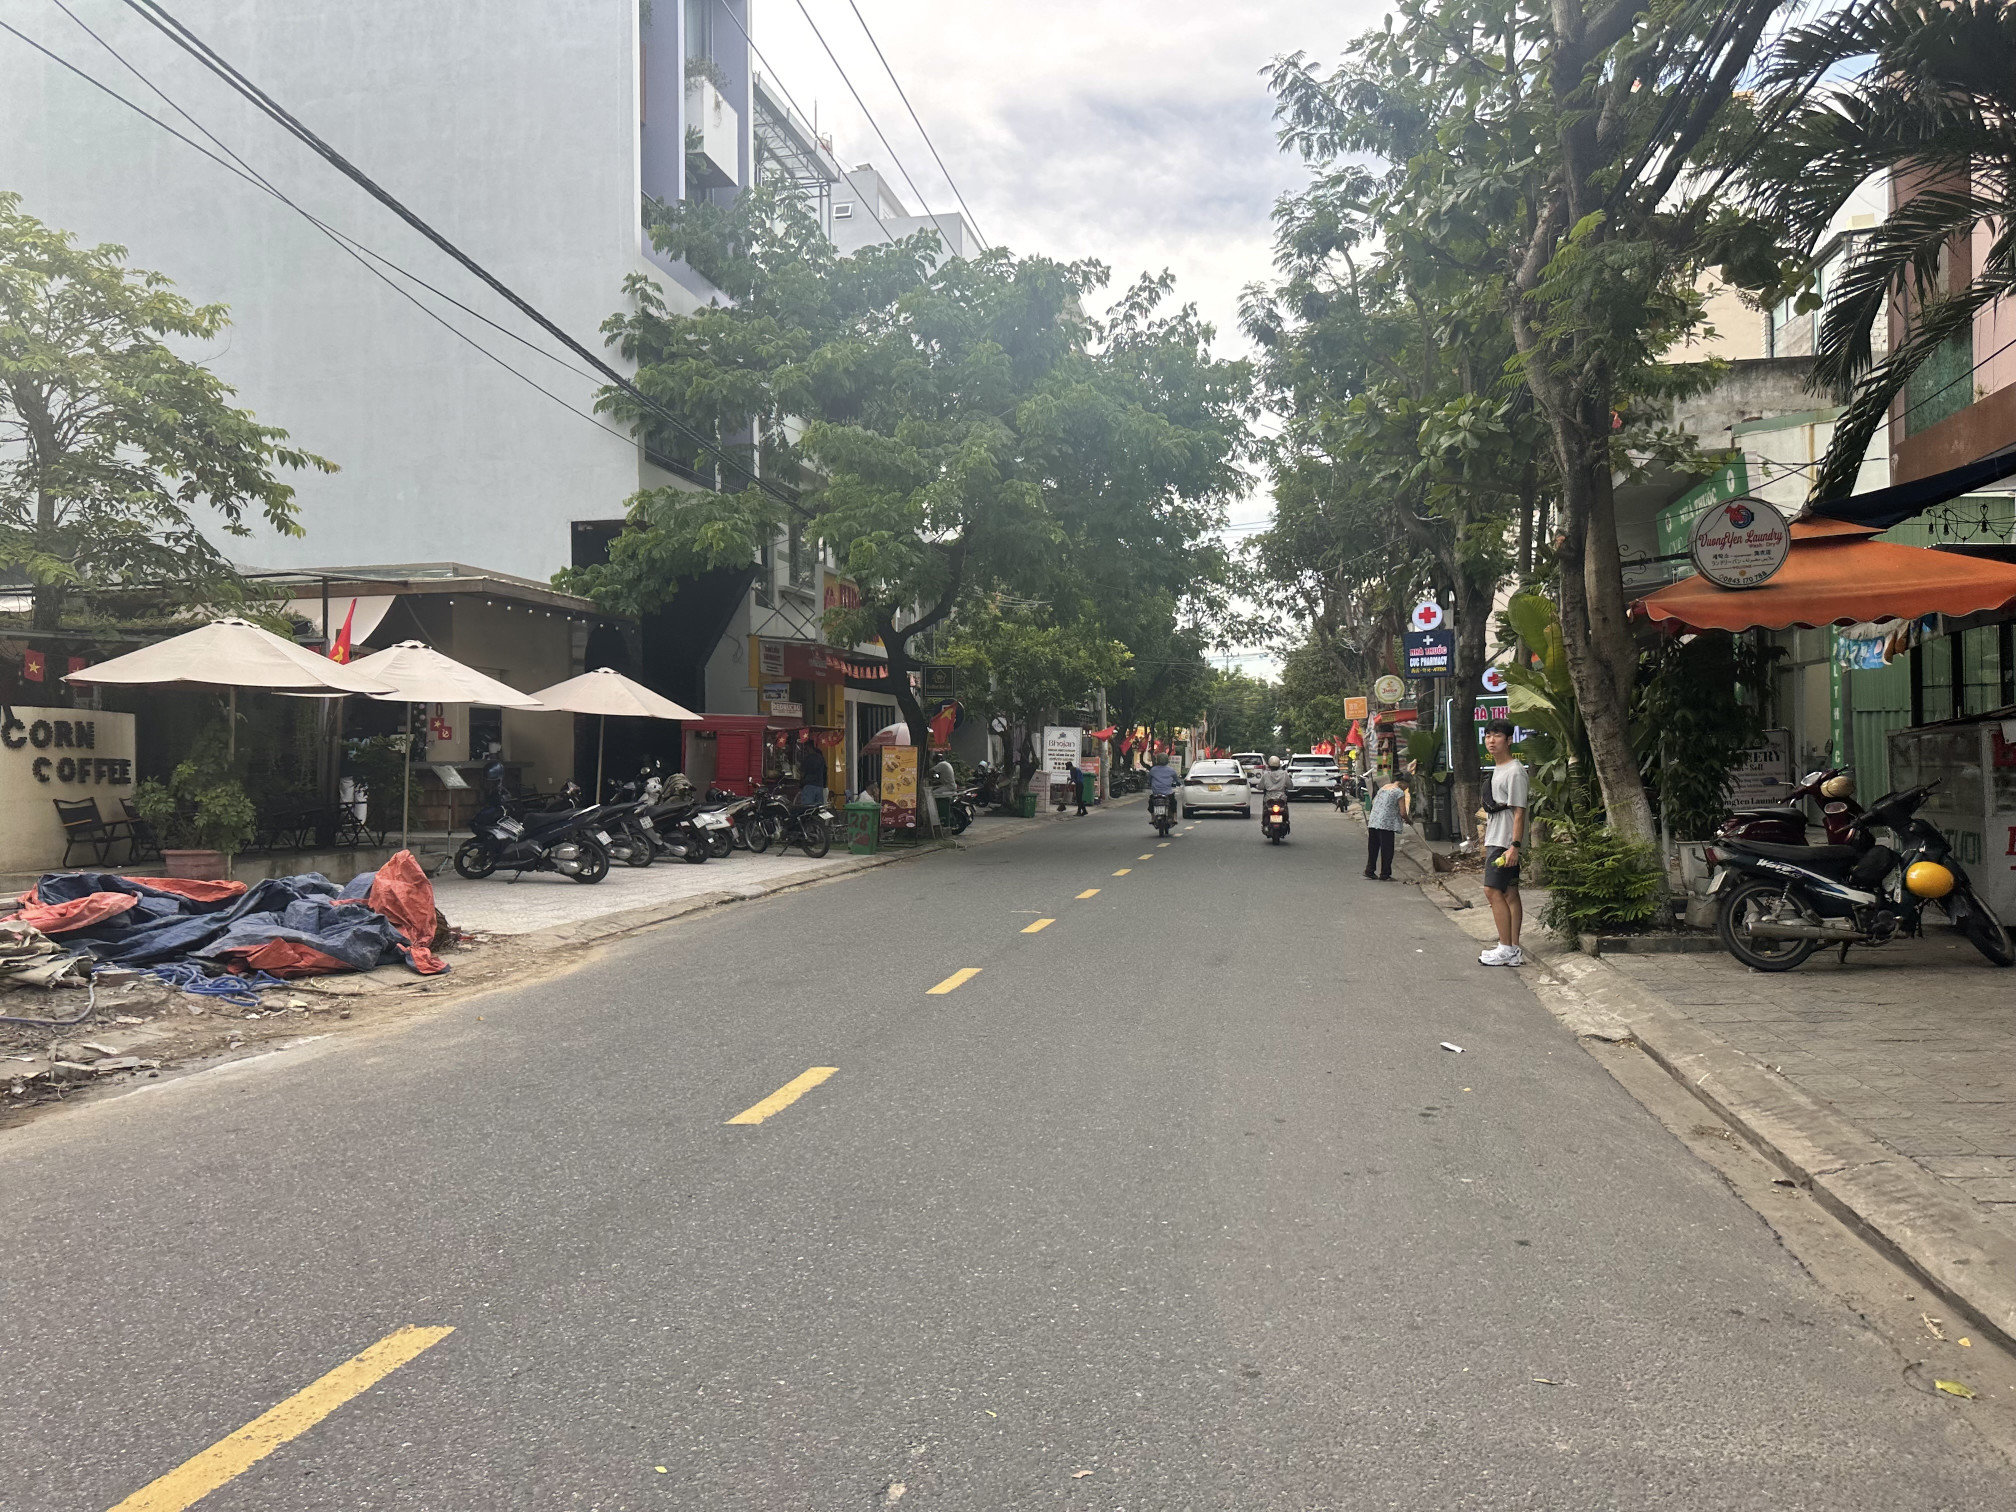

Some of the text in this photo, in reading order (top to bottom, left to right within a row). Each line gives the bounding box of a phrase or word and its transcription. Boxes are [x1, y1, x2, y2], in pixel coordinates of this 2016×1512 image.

[1745, 528, 1784, 545] Laundry
[1410, 644, 1447, 656] NHÀ THUỐC
[1421, 655, 1448, 667] PHARMACY
[1, 719, 95, 749] CORN
[32, 756, 131, 785] COFFEE
[1756, 858, 1797, 873] Wave
